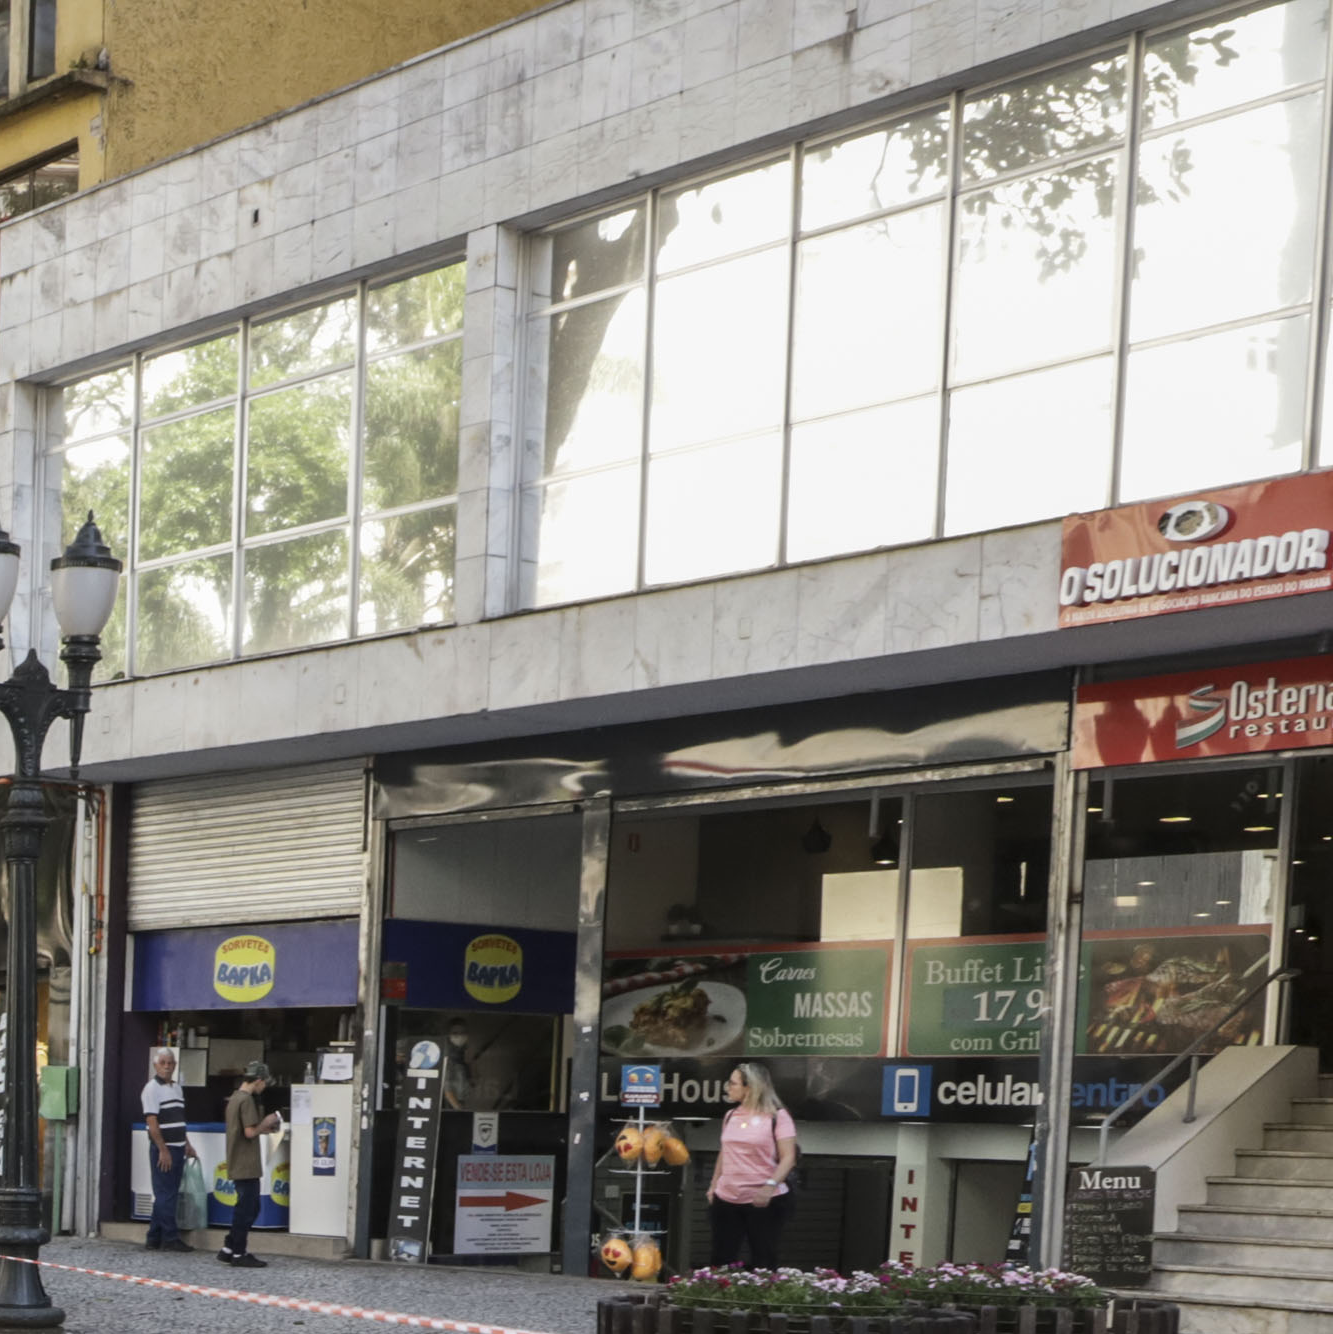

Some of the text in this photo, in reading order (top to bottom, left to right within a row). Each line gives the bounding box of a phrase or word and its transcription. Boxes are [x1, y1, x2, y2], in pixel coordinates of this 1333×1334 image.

[1060, 528, 1330, 606] O SOLUCIONADOR
[1229, 716, 1333, 739] restau
[221, 938, 270, 954] SORVETES
[471, 938, 519, 955] SORVETES
[216, 961, 273, 987] BAPKA
[465, 960, 521, 986] BAPKA
[759, 957, 816, 984] Carnes
[924, 958, 1004, 985] Buffet
[794, 991, 872, 1019] MASSAS
[748, 1027, 864, 1049] Sobremesas
[950, 1037, 994, 1051] com
[397, 1077, 432, 1228] INTERNET
[505, 1161, 527, 1183] ESTA
[529, 1161, 551, 1183] LOJA
[1079, 1170, 1141, 1190] Menu
